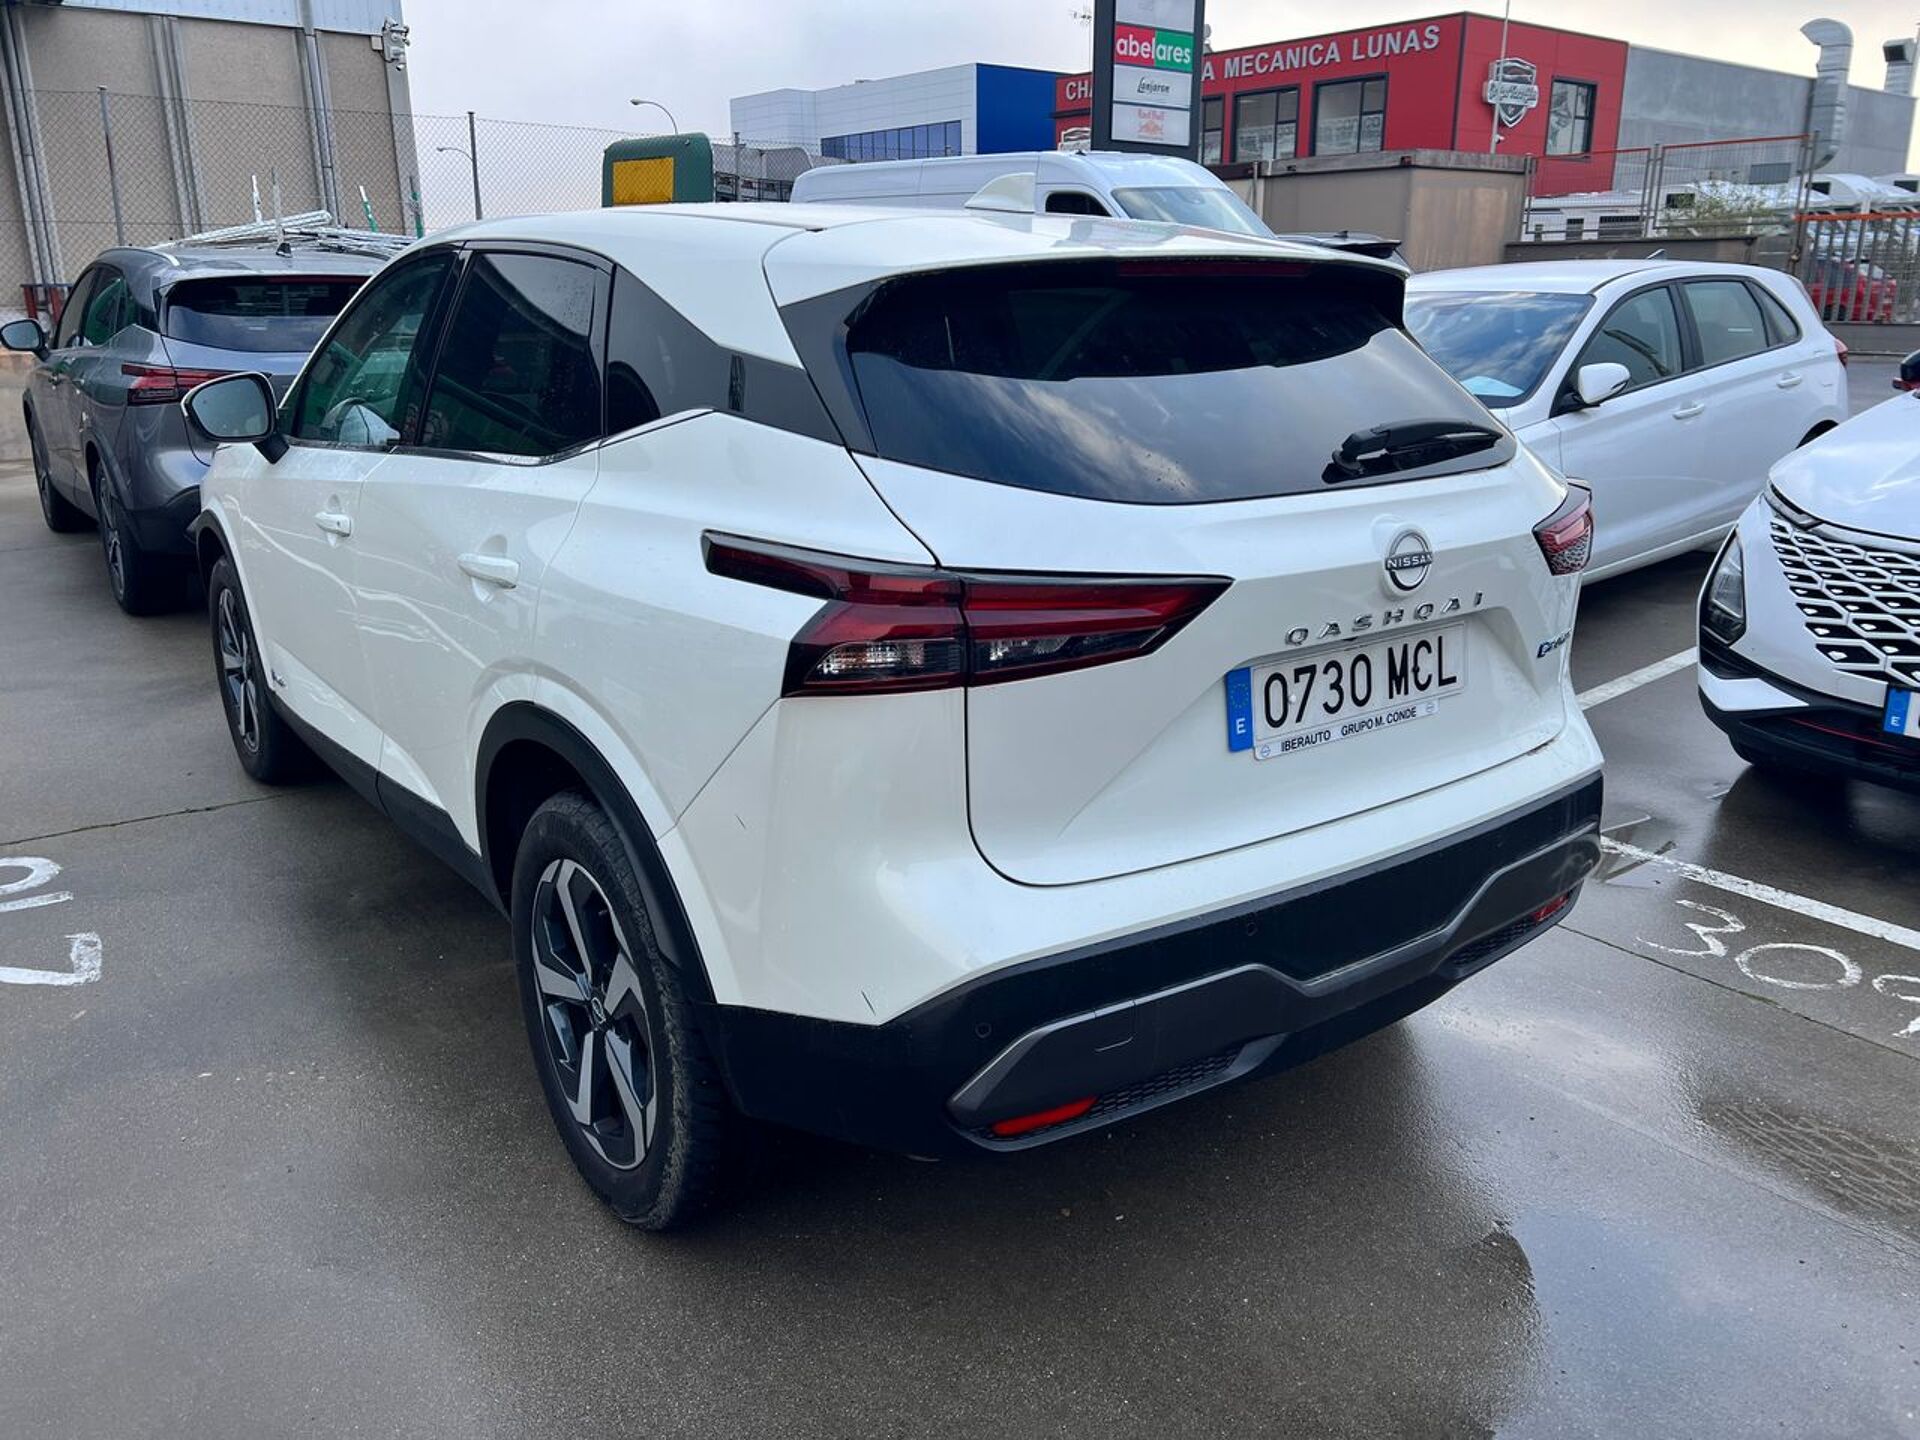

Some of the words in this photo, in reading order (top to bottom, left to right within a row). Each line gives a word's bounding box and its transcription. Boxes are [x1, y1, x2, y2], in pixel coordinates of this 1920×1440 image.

[1066, 80, 1092, 100] CH
[1224, 41, 1341, 79] MECANICA
[1352, 25, 1440, 61] LUNAS
[1116, 33, 1191, 64] abelares
[1386, 553, 1433, 570] NISSAN
[1285, 590, 1484, 646] QASHQAI
[1263, 653, 1372, 729] 0730
[1387, 635, 1458, 700] MCL
[1235, 717, 1247, 735] E
[1281, 729, 1332, 752] IBERAUTO
[1340, 718, 1373, 737] GRUPO
[1374, 715, 1386, 729] M.
[1386, 705, 1418, 725] CONDE
[1890, 715, 1901, 727] E
